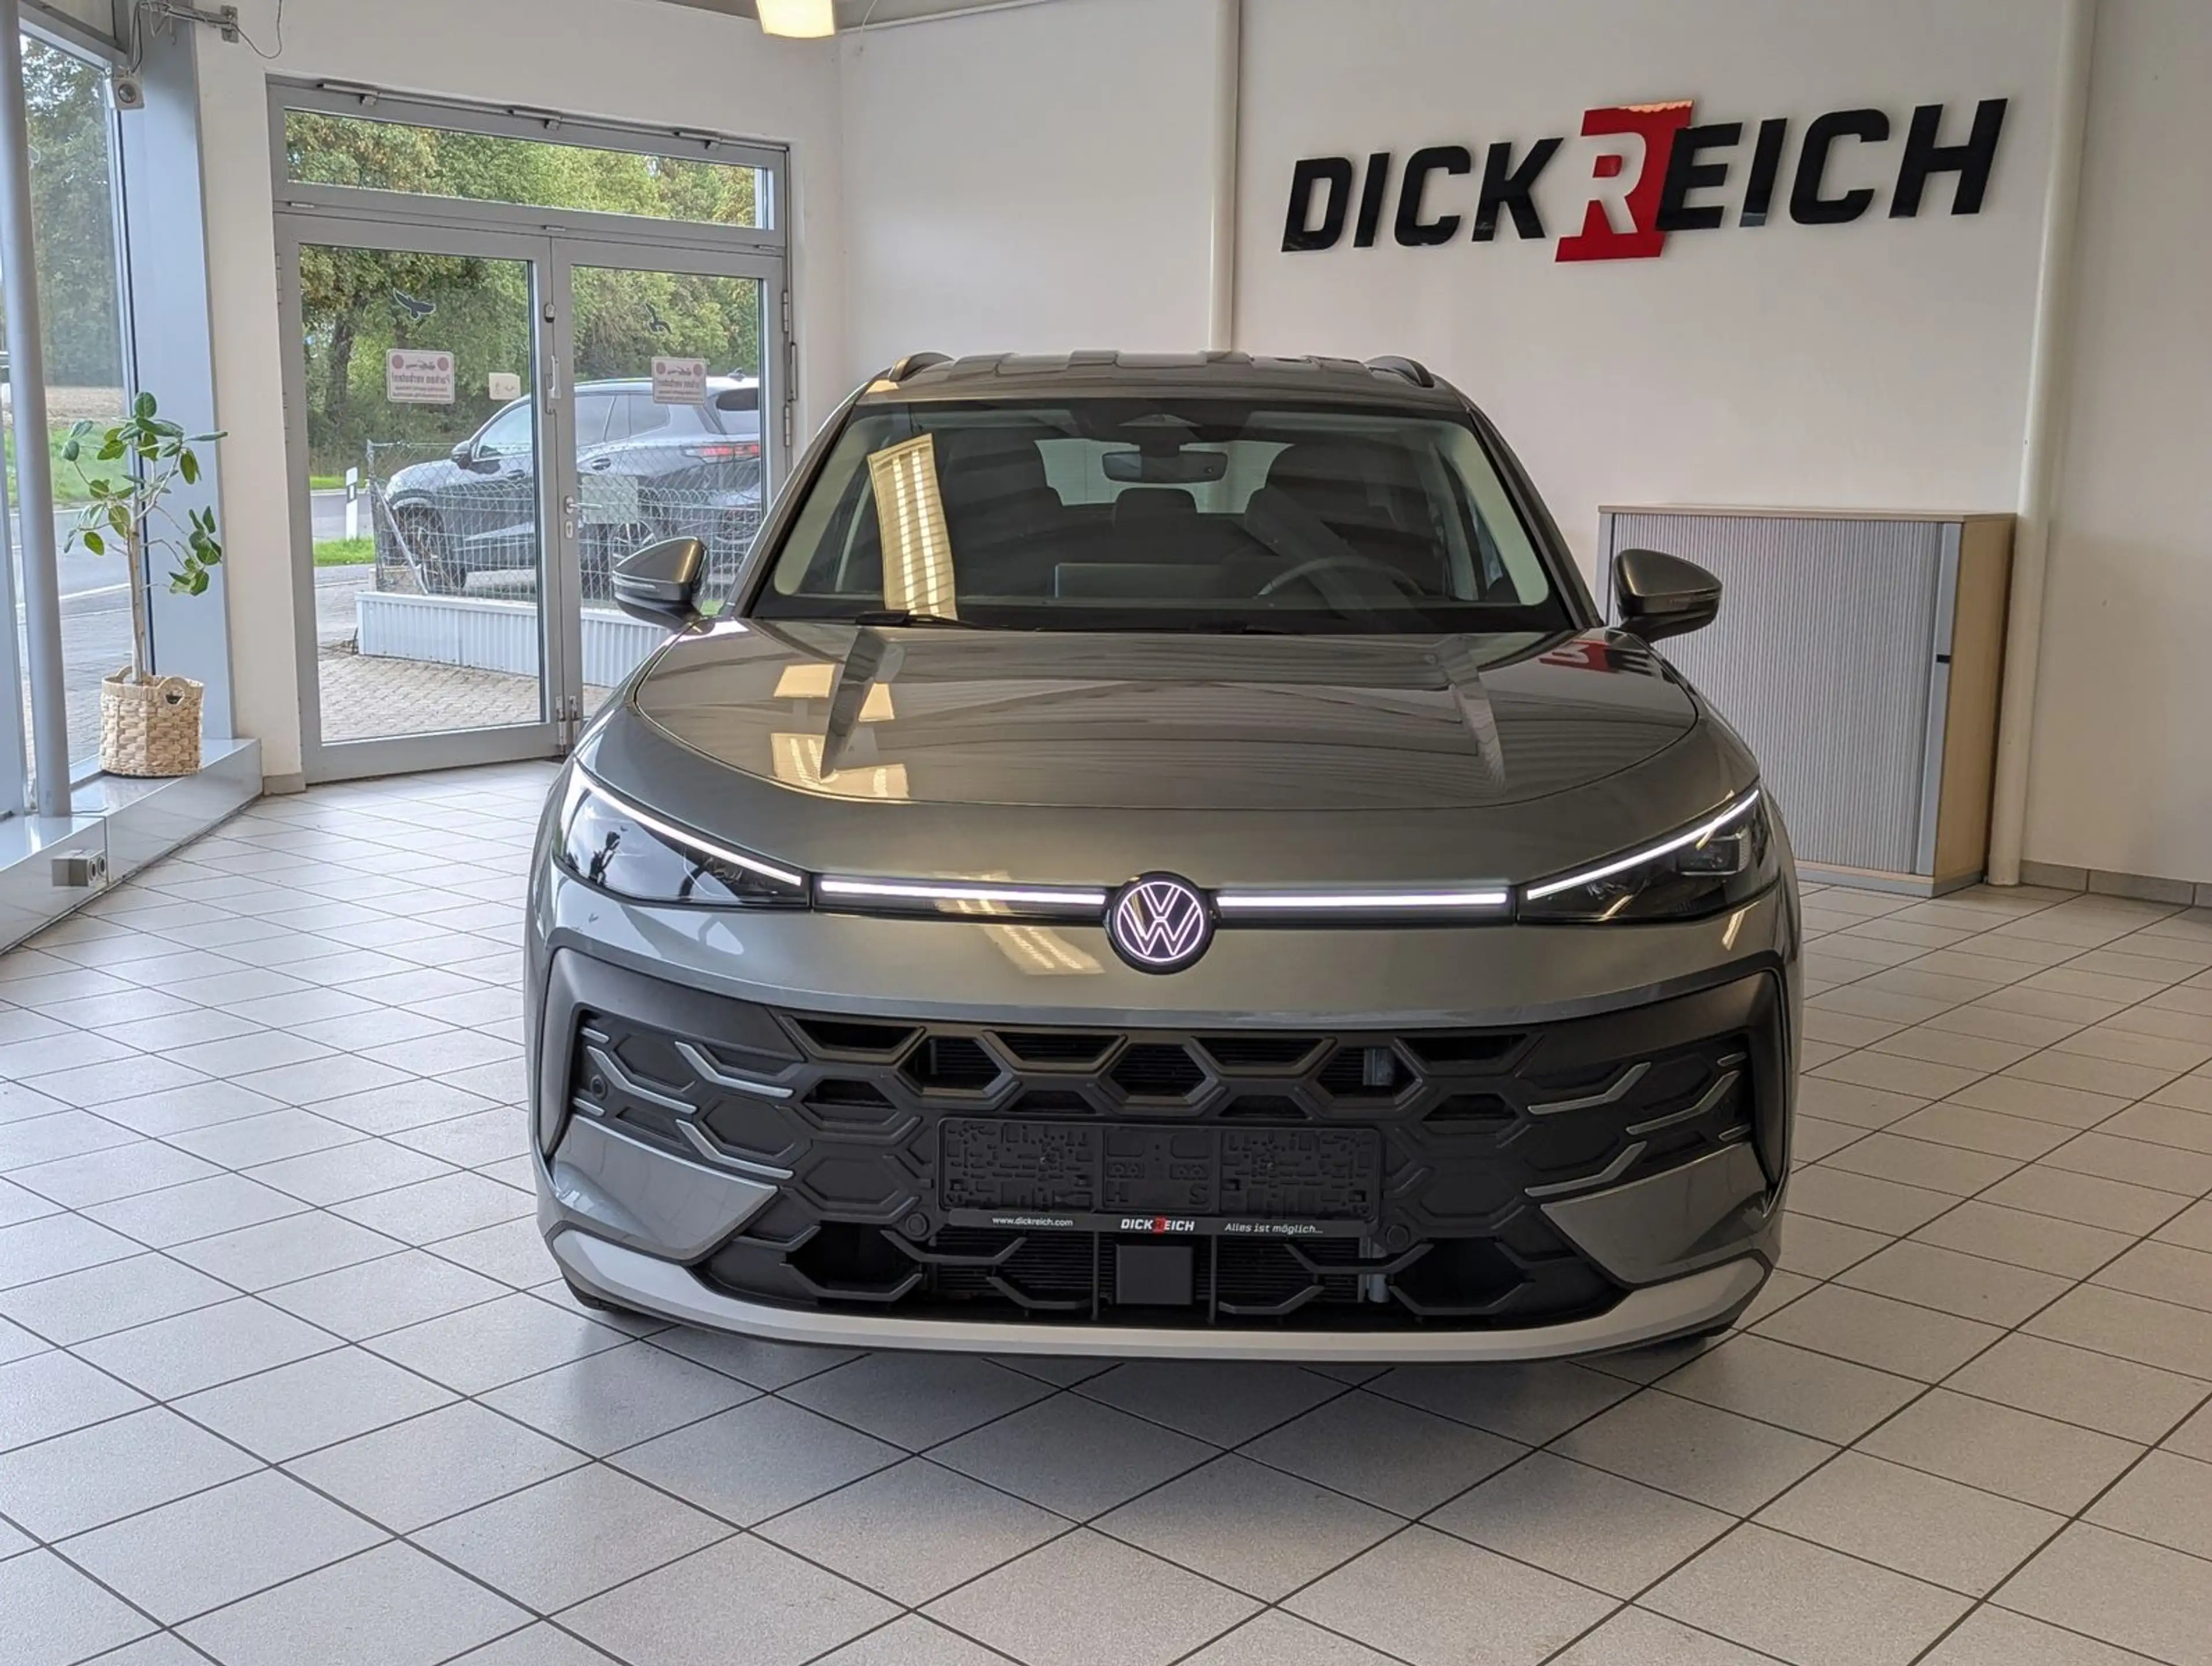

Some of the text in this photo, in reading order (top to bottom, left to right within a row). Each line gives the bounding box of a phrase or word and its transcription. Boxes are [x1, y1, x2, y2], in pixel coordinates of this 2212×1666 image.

[1281, 98, 2008, 262] DICKREICH
[1120, 884, 1201, 956] VW
[992, 1217, 1073, 1227] www.dickreich.com
[1224, 1223, 1252, 1232] Alles
[1253, 1223, 1270, 1233] ist
